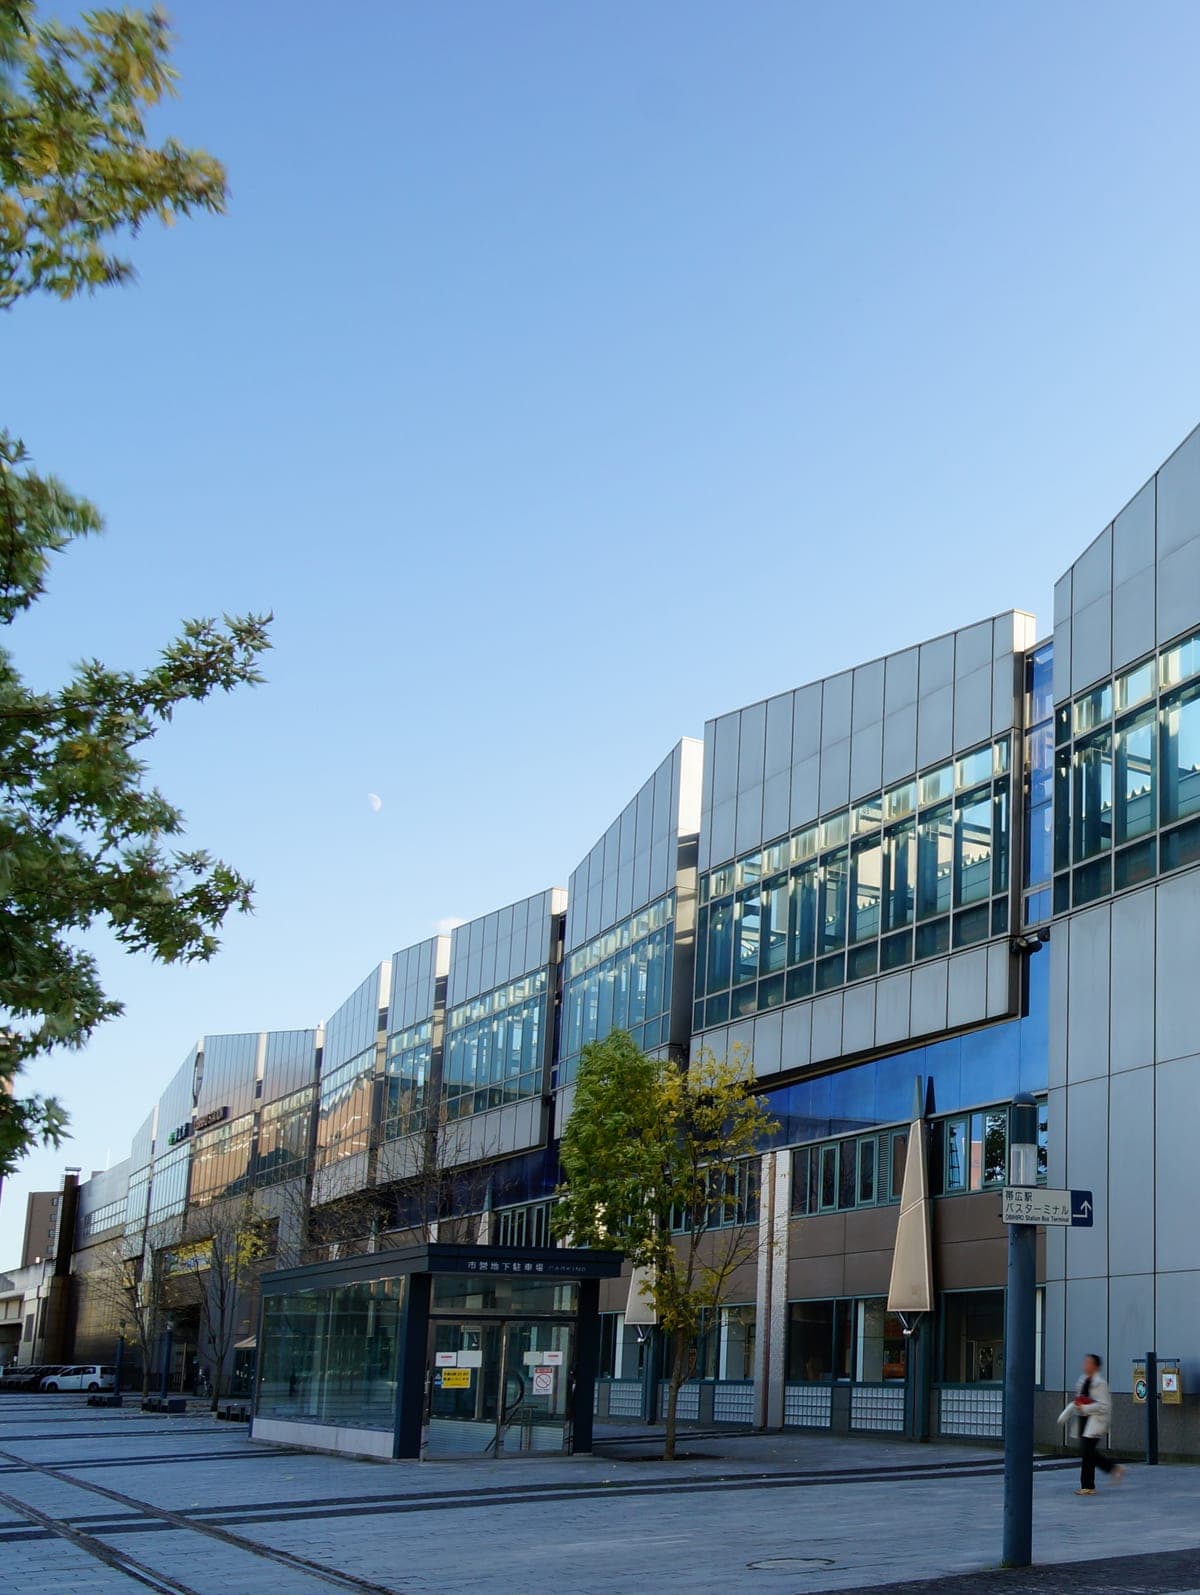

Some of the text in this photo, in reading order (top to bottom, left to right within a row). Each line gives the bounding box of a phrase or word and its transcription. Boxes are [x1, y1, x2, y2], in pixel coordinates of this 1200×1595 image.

[1006, 1190, 1033, 1202] 帯広駅
[1006, 1202, 1069, 1215] バスターミナル
[467, 1261, 544, 1272] 市営地下駐車場
